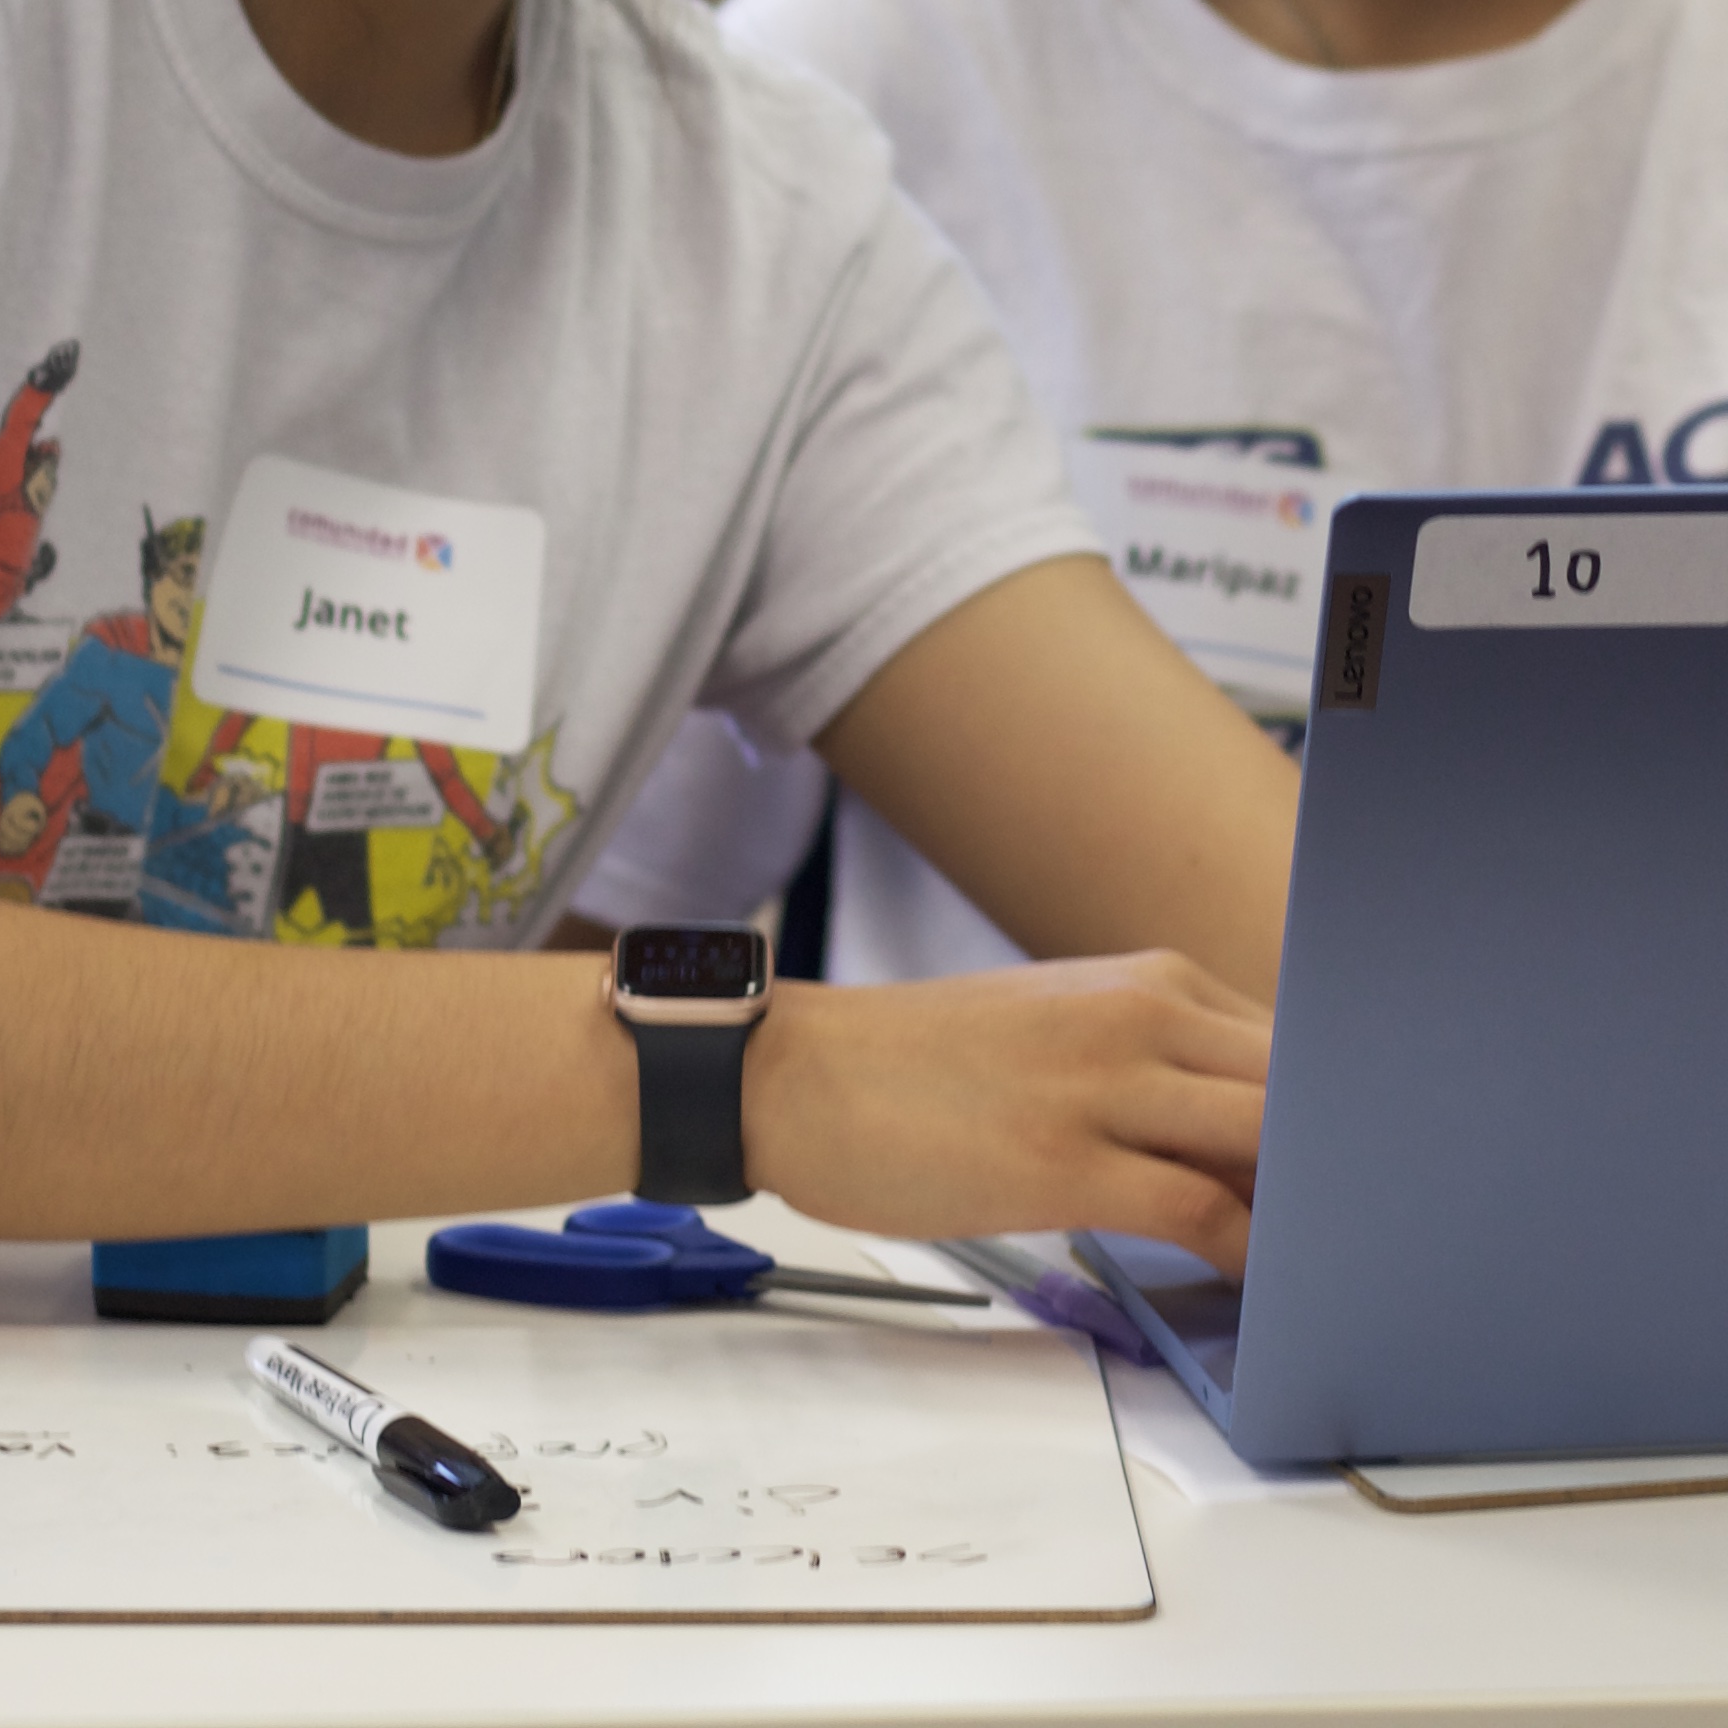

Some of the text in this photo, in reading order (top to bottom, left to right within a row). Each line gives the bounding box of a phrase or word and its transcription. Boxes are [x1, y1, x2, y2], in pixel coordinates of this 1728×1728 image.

[1127, 543, 1299, 602] Maripaz
[1526, 538, 1601, 599] 10
[293, 585, 409, 641] Janet
[1334, 585, 1373, 701] Lenovo
[634, 1484, 843, 1518] div
